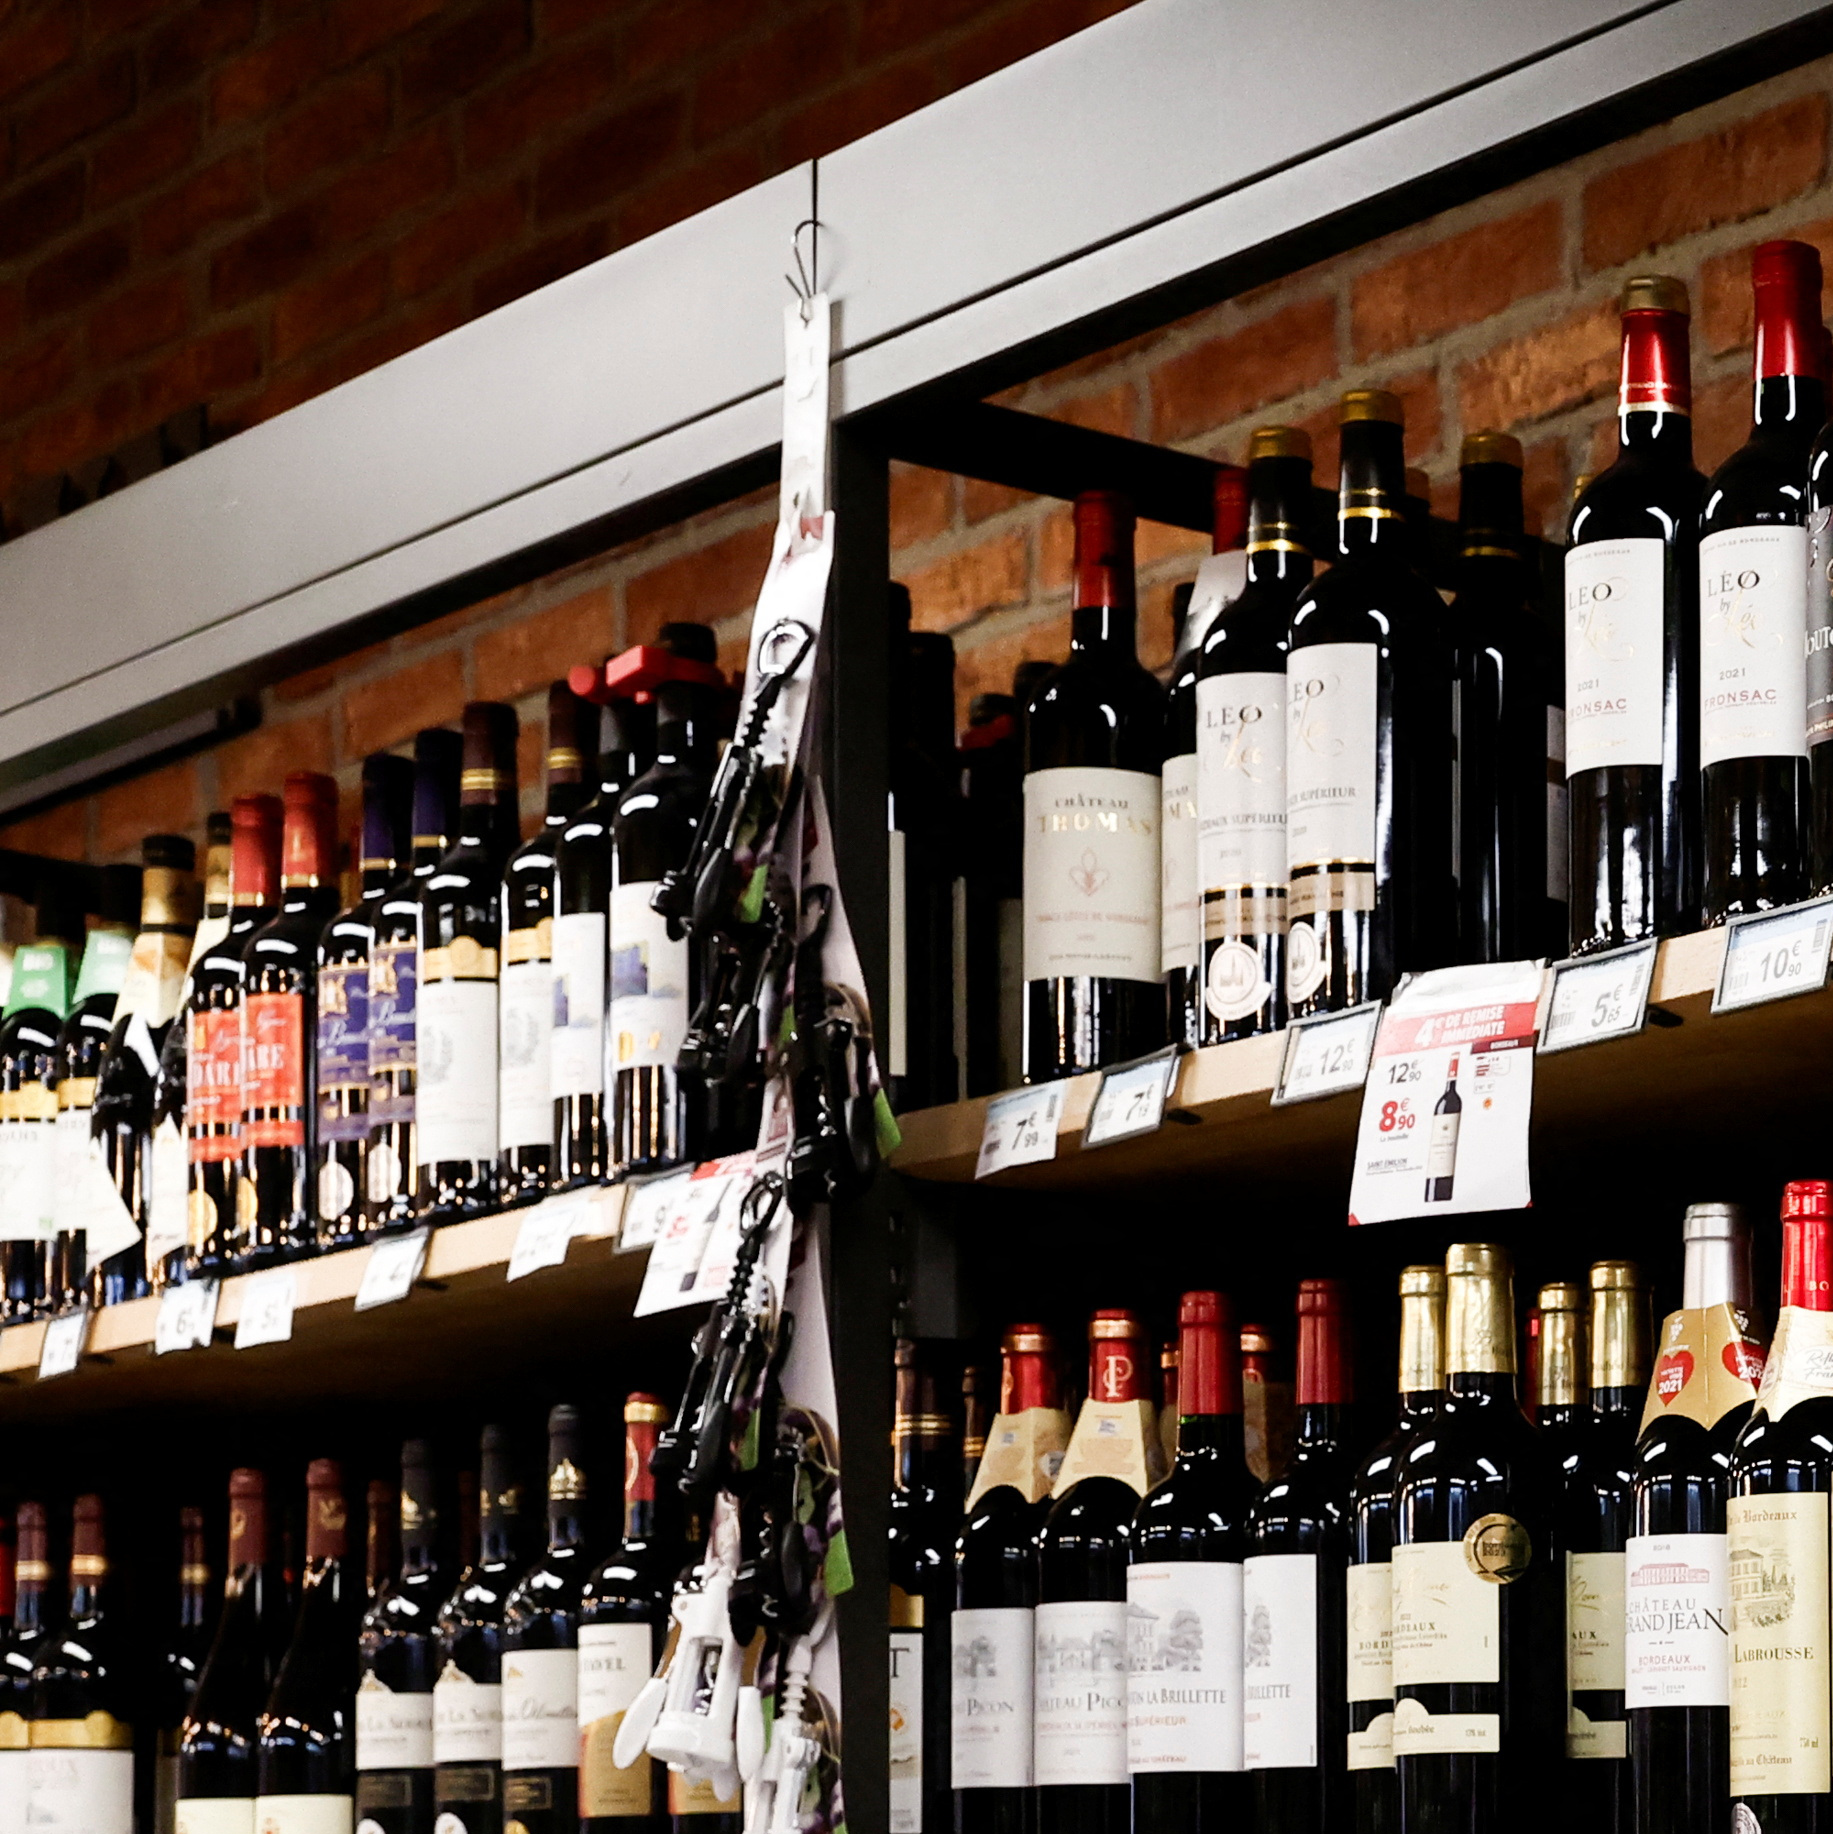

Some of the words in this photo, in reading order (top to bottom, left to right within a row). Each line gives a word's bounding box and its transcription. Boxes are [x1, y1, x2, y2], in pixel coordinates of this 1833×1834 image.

[1720, 668, 1746, 680] 2021
[1704, 689, 1776, 710] FRONSAC
[1445, 1015, 1460, 1028] DE
[1463, 1006, 1504, 1023] REMISE
[1441, 1021, 1505, 1043] IMMÉDIATE
[1658, 1380, 1683, 1393] 2021
[1733, 1645, 1813, 1663] LABROUSSE
[1161, 1689, 1226, 1704] BRILLETTE
